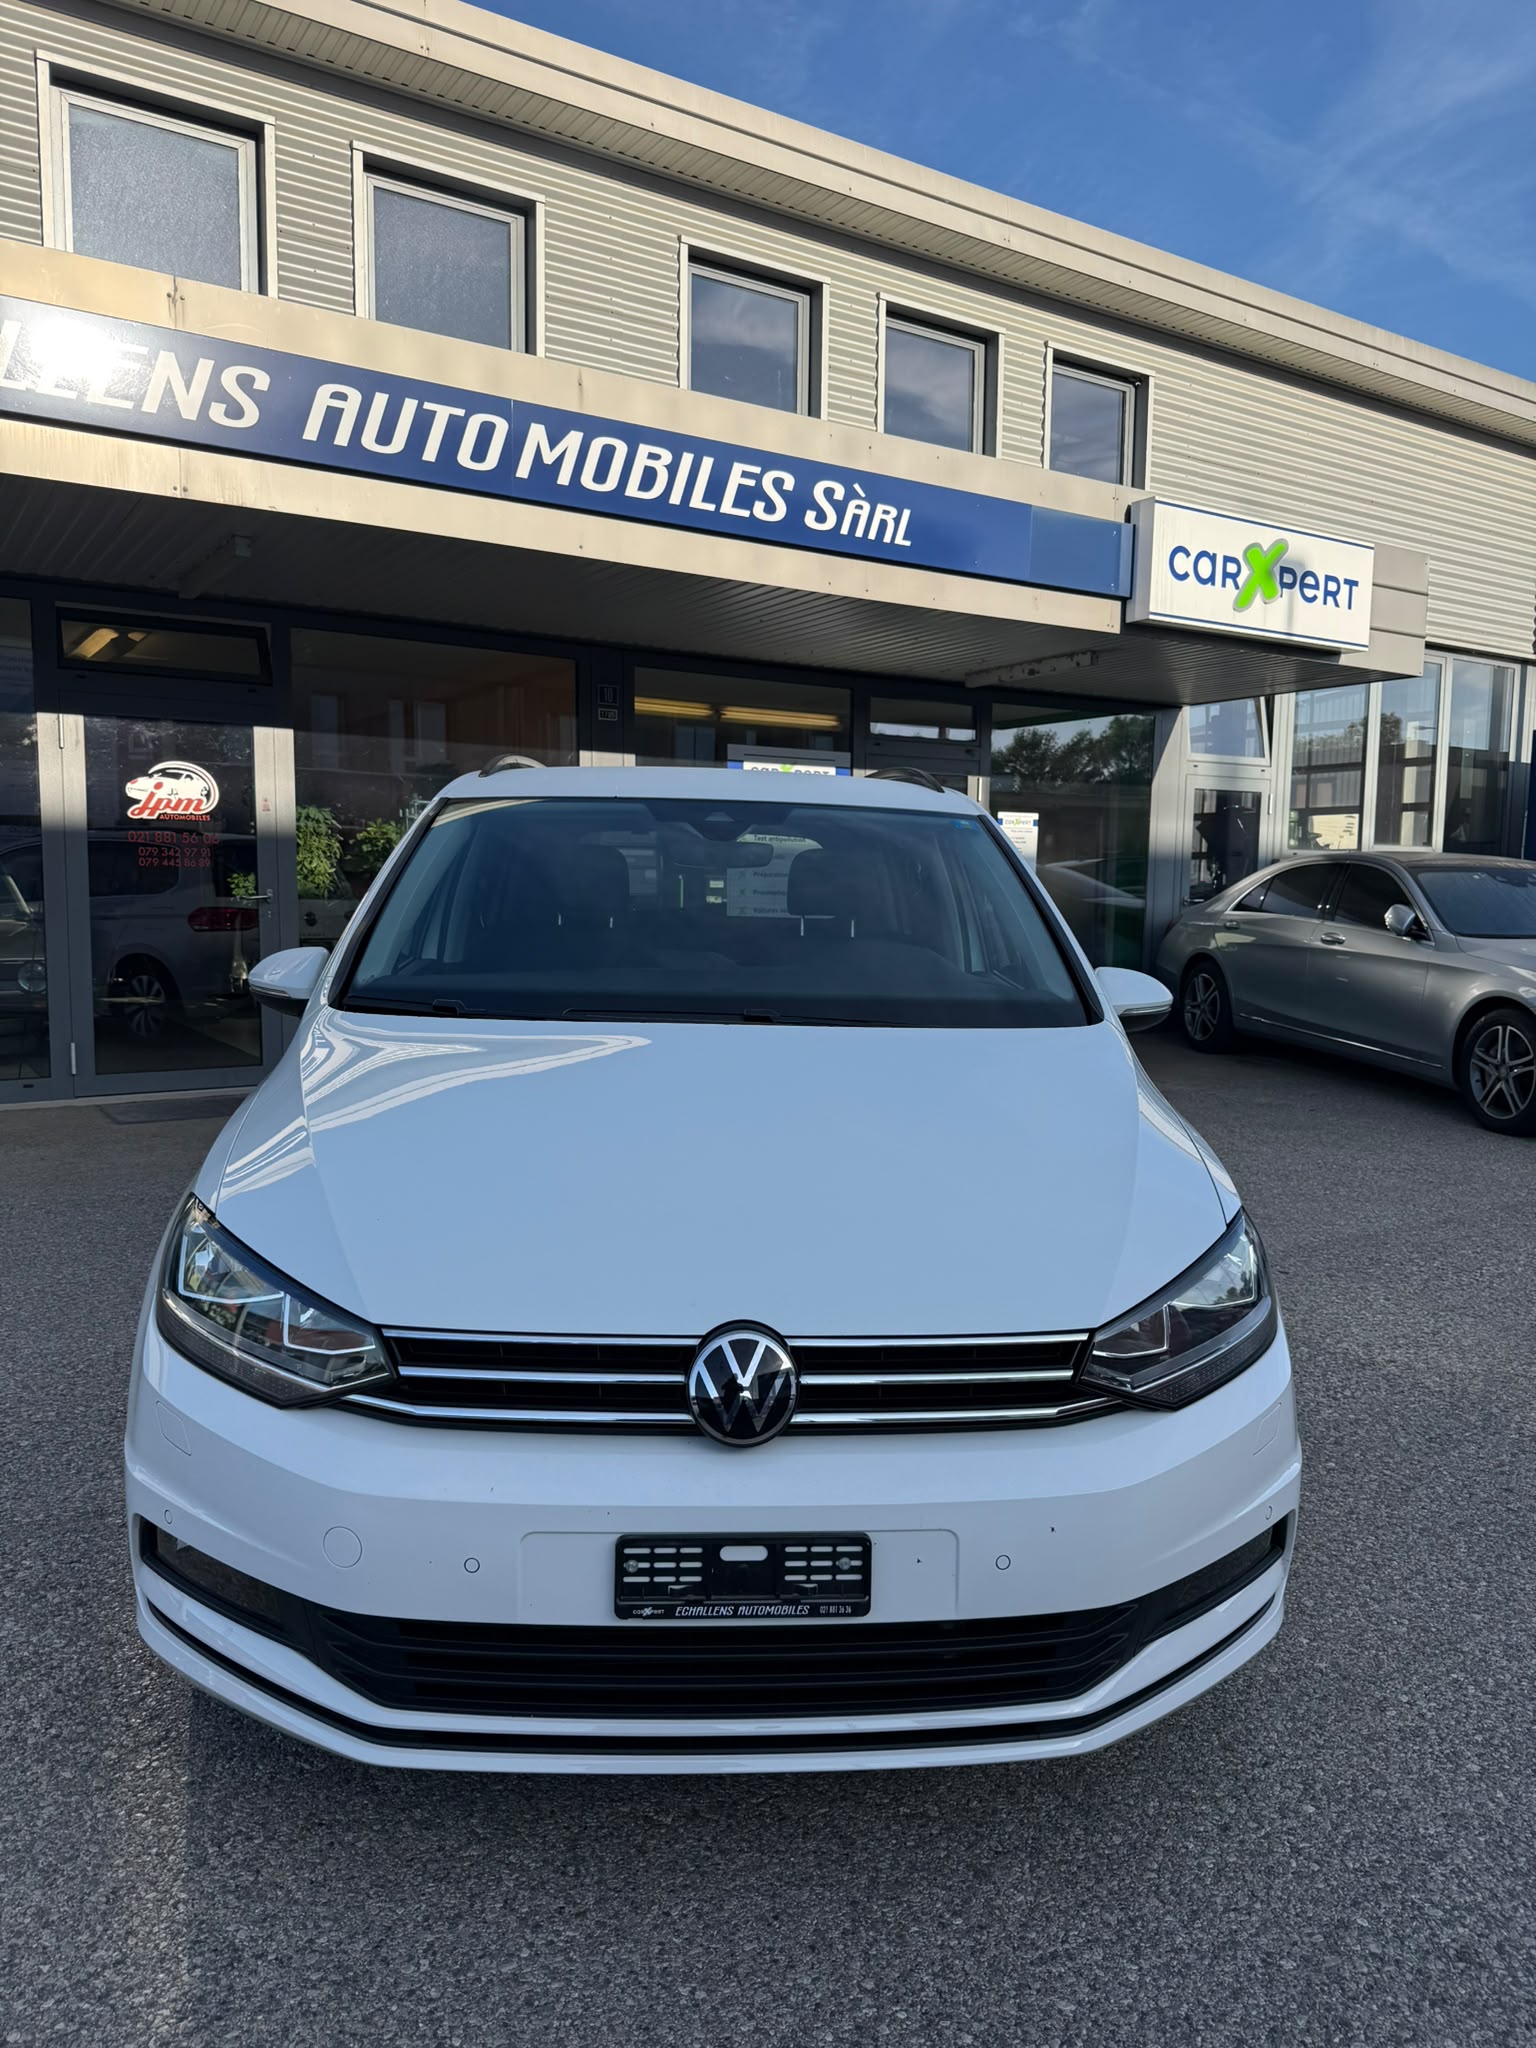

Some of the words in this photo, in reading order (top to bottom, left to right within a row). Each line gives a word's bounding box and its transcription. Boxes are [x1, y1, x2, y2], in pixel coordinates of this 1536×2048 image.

[127, 831, 149, 843] 021
[154, 831, 176, 844] 881
[182, 832, 198, 844] 56
[202, 833, 220, 844] 06
[138, 847, 159, 857] 079
[161, 847, 181, 857] 342
[184, 848, 197, 857] 97
[200, 848, 211, 857] 91
[138, 858, 159, 867] 079
[675, 1606, 734, 1617] ECHALLENS
[738, 1605, 810, 1616] AUTOMOBILES
